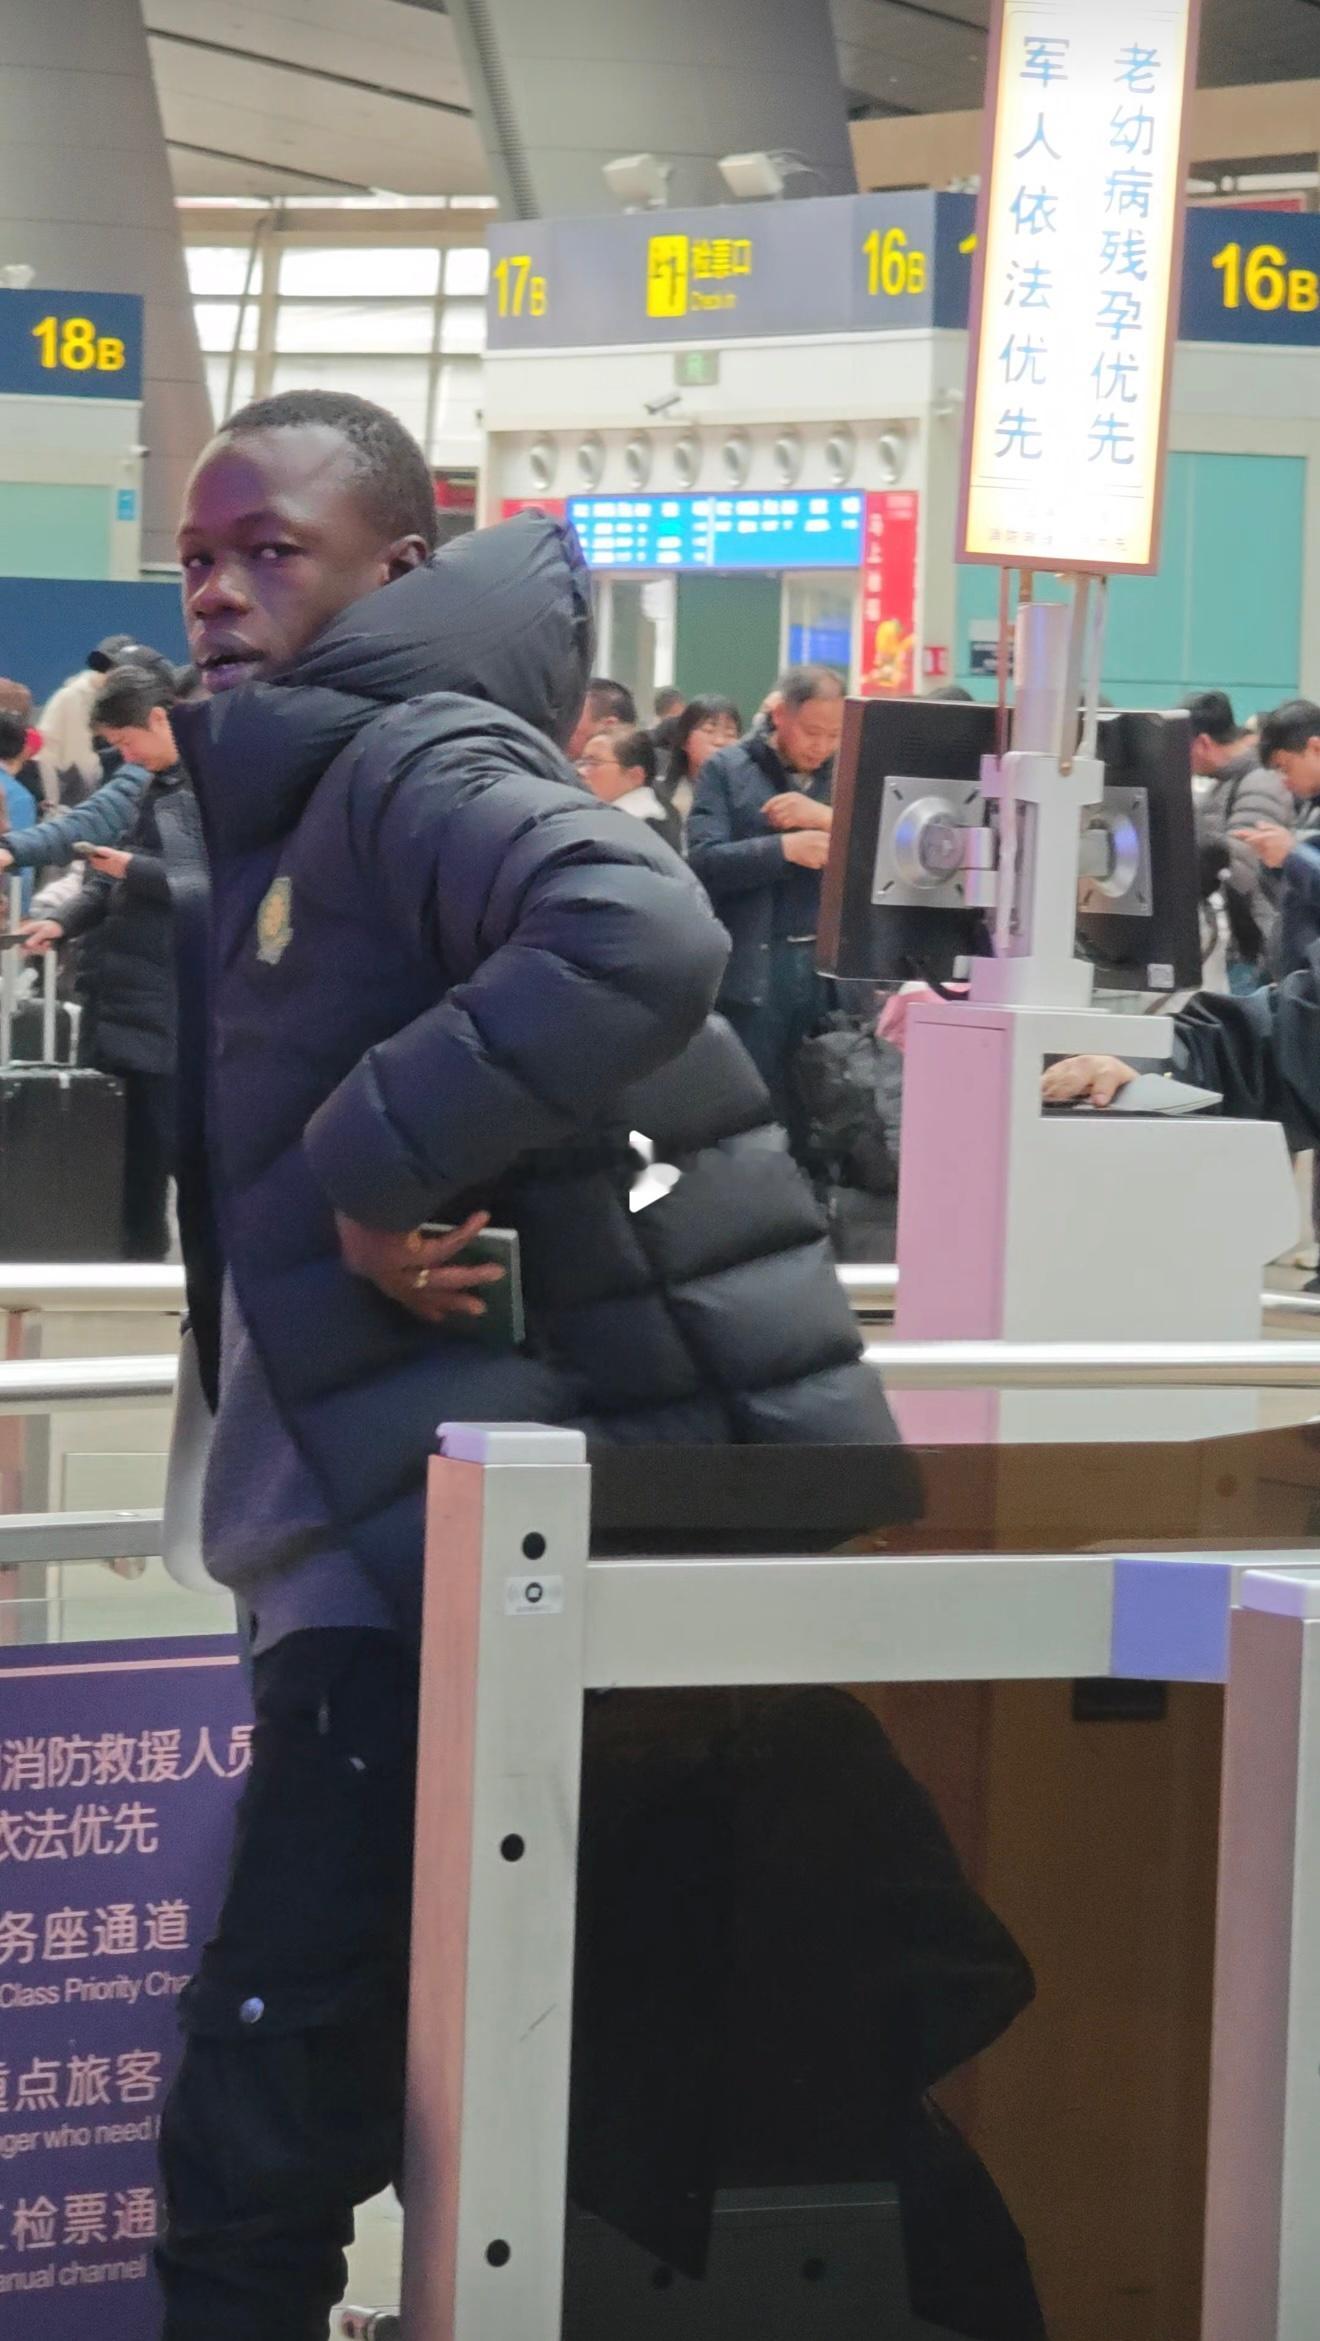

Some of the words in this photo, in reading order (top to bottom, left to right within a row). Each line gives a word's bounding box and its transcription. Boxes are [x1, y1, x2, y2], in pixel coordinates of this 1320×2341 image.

[862, 227, 927, 296] 16B
[994, 36, 1070, 460] 军人依法优先
[1087, 42, 1161, 465] 老幼病残孕优先
[1211, 242, 1319, 312] 16B
[494, 255, 547, 318] 17B
[32, 316, 125, 371] 18B
[64, 1976, 142, 2004] Priority
[44, 2122, 91, 2149] who
[95, 2115, 152, 2145] need
[0, 2187, 157, 2252] 检票通
[58, 2252, 148, 2287] channel
